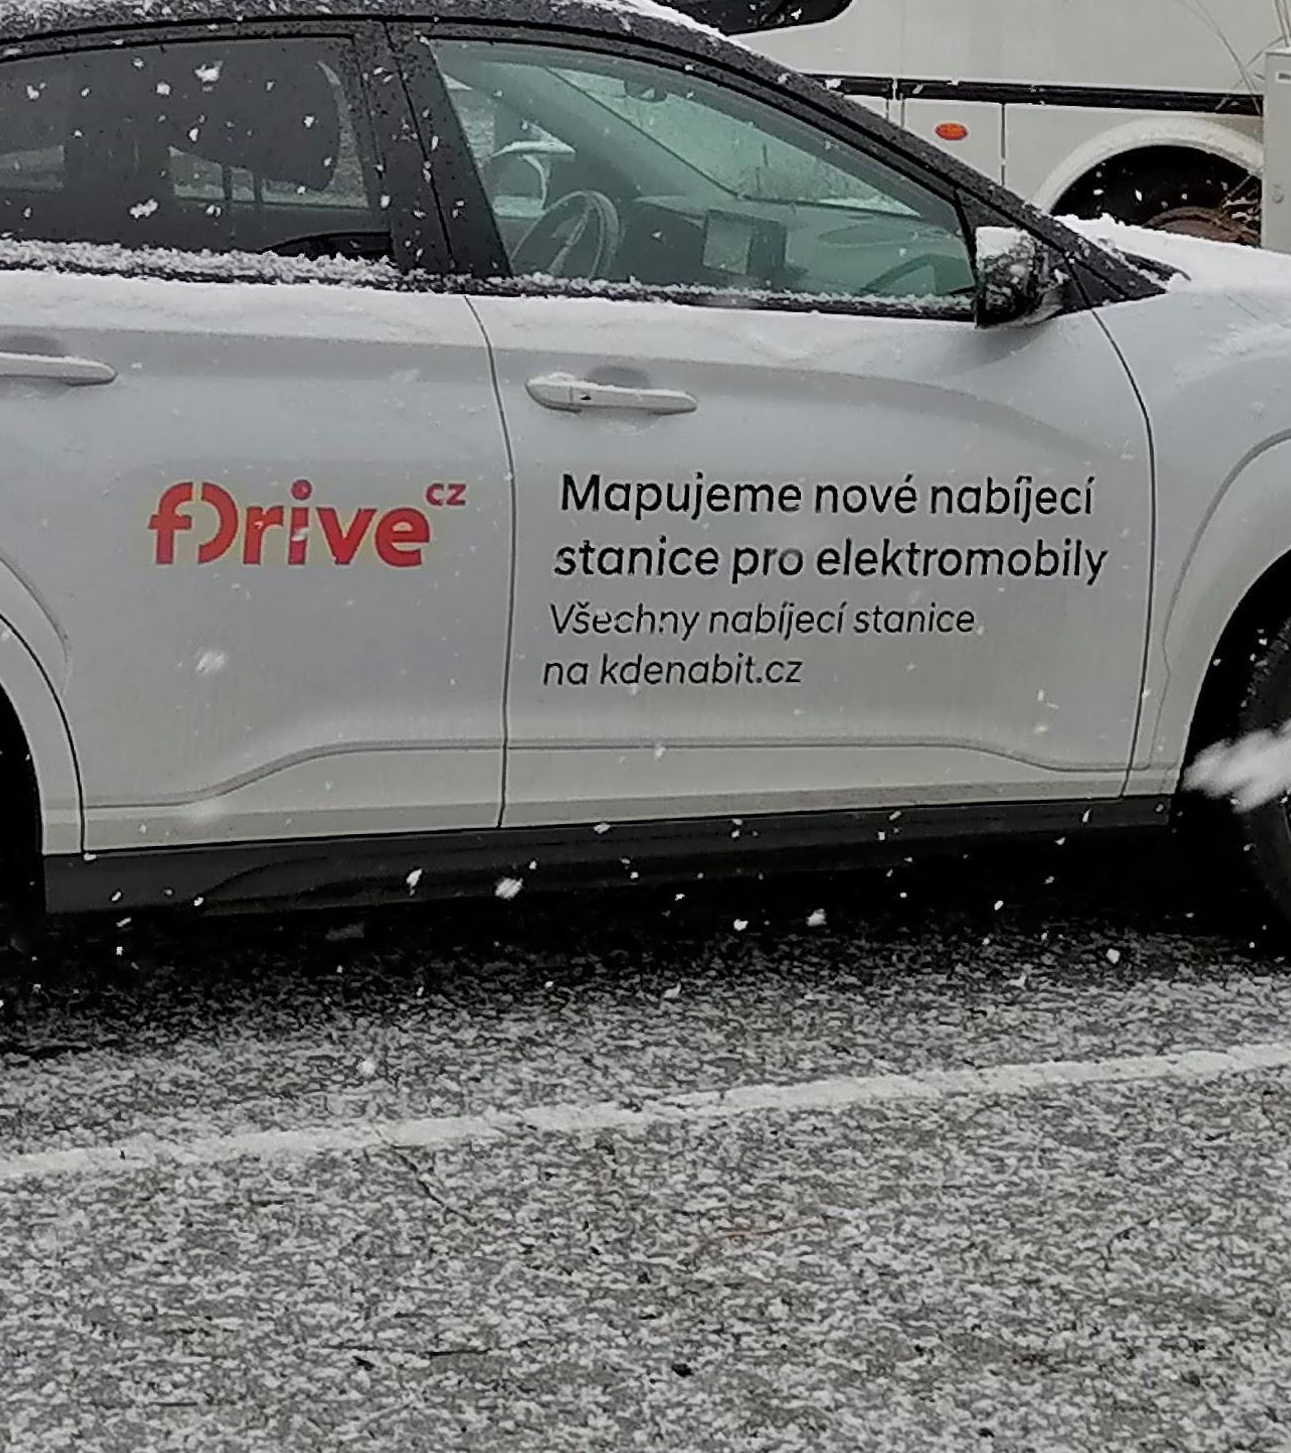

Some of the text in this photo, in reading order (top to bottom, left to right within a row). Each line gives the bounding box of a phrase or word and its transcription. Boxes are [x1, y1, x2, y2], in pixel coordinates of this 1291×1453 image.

[147, 478, 431, 568] fDrive
[560, 471, 1096, 524] Mapujeme nové nabíjecí
[554, 534, 1109, 586] stanice pro elektromobily
[549, 600, 976, 642] Všechny nabíjecí stanice
[542, 651, 804, 686] na kdenabit.cz
